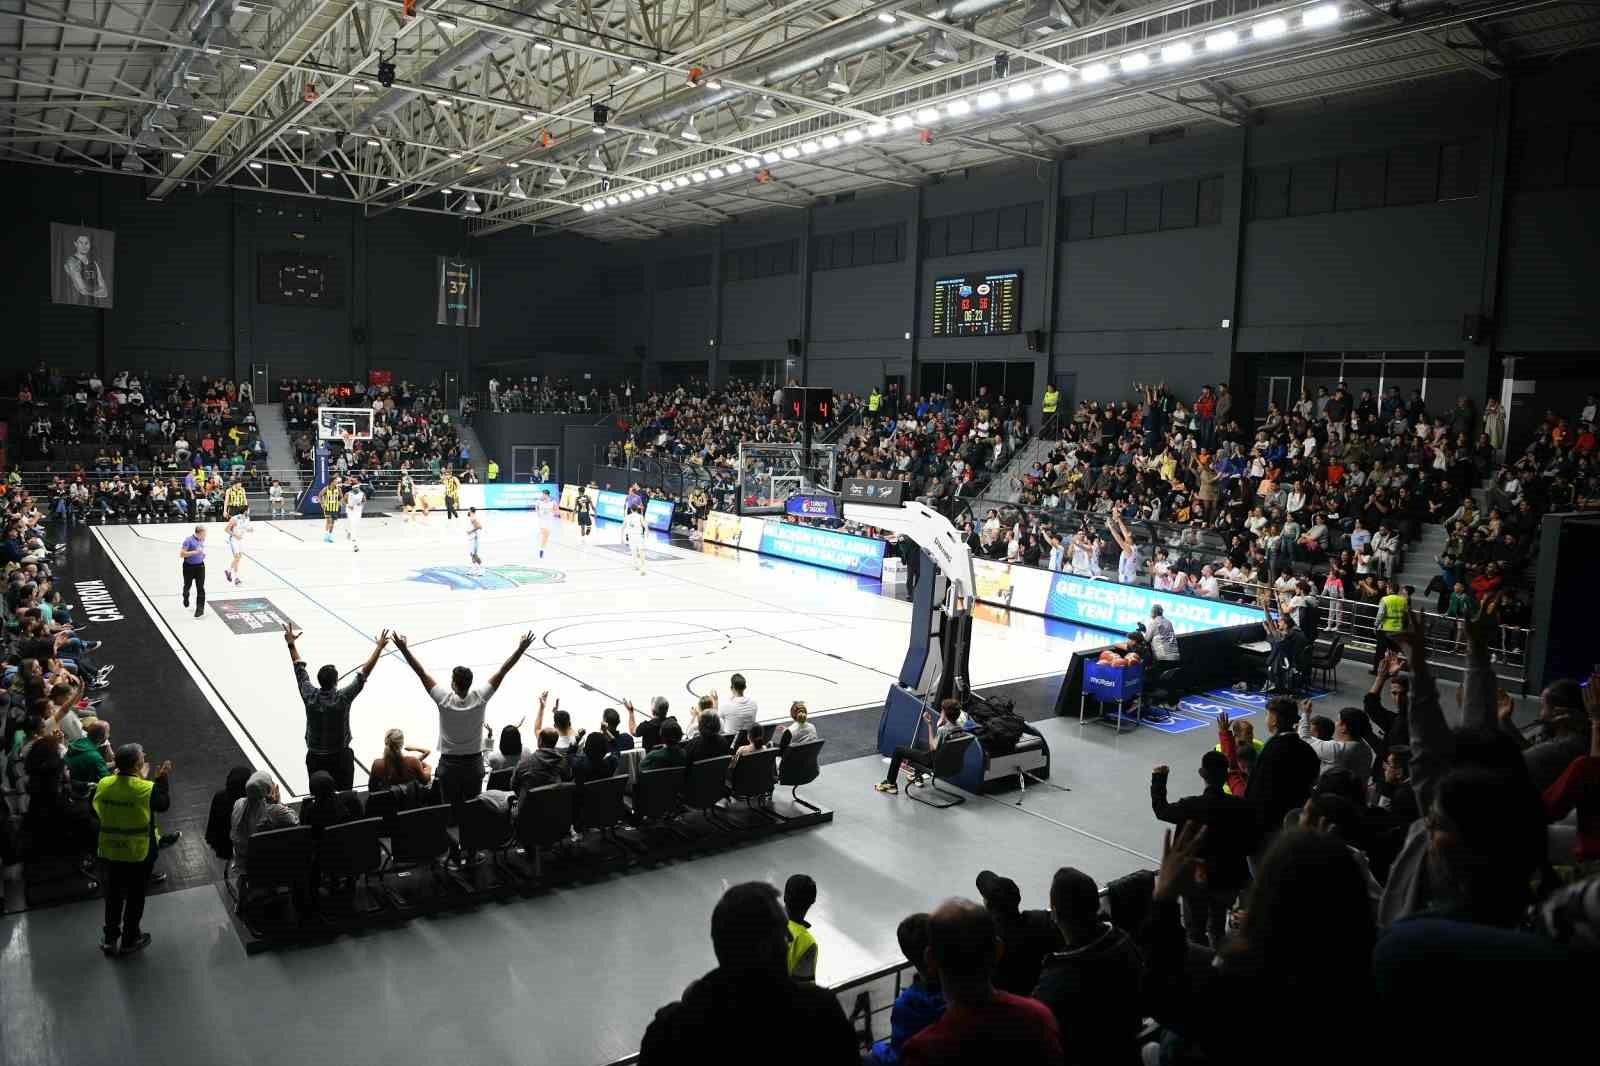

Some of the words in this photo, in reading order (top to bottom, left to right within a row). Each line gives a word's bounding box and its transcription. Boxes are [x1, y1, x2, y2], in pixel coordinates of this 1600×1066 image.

[449, 280, 467, 295] 37
[793, 401, 800, 417] 4
[819, 401, 827, 417] 4
[1077, 601, 1112, 622] YENİ
